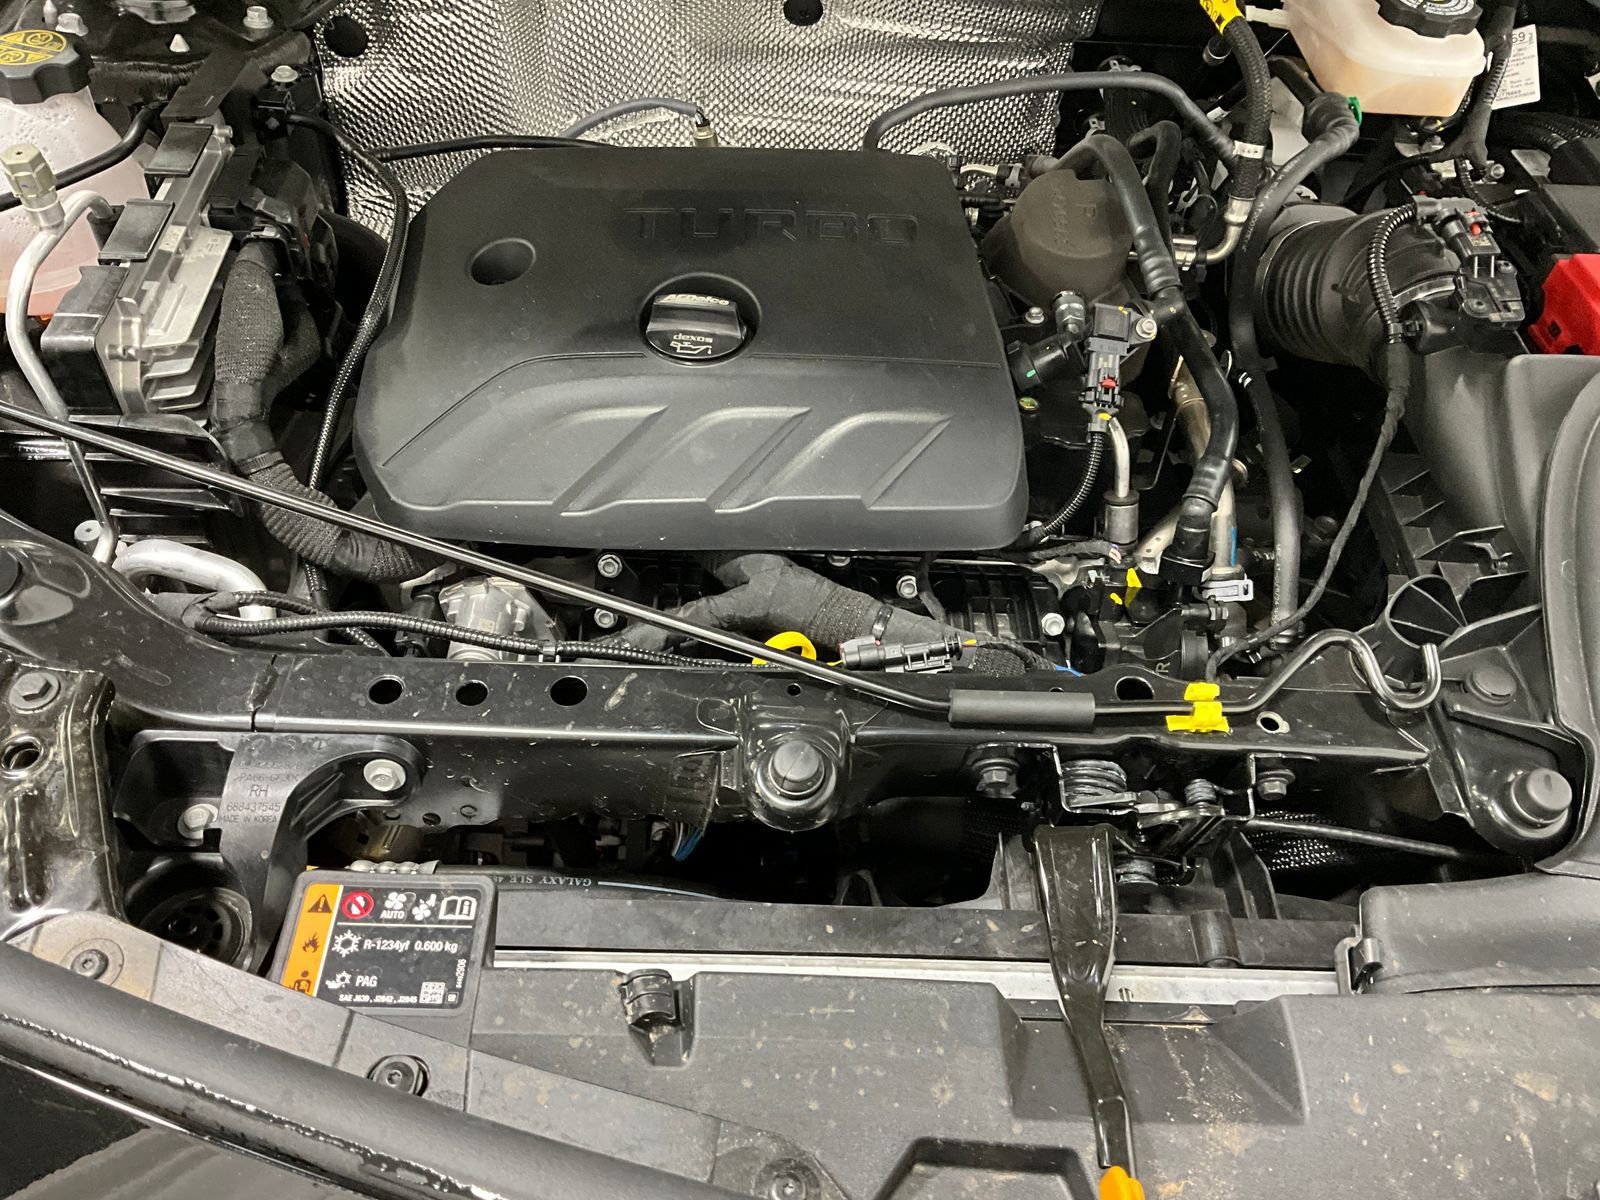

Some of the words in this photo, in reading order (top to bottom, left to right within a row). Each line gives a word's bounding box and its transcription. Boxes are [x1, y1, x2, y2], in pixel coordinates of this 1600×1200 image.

[623, 207, 919, 244] TURBO
[673, 333, 713, 343] dexos
[250, 784, 269, 797] RH
[219, 815, 239, 823] MADE
[254, 815, 277, 823] KOREA
[509, 875, 534, 884] SLE
[539, 876, 592, 887] GALAXY
[380, 910, 405, 920] AUTO
[363, 940, 410, 951] R-1234yf
[414, 941, 443, 951] 0.600
[444, 941, 458, 953] kg
[355, 975, 378, 987] PAG
[339, 994, 352, 1002] SAE
